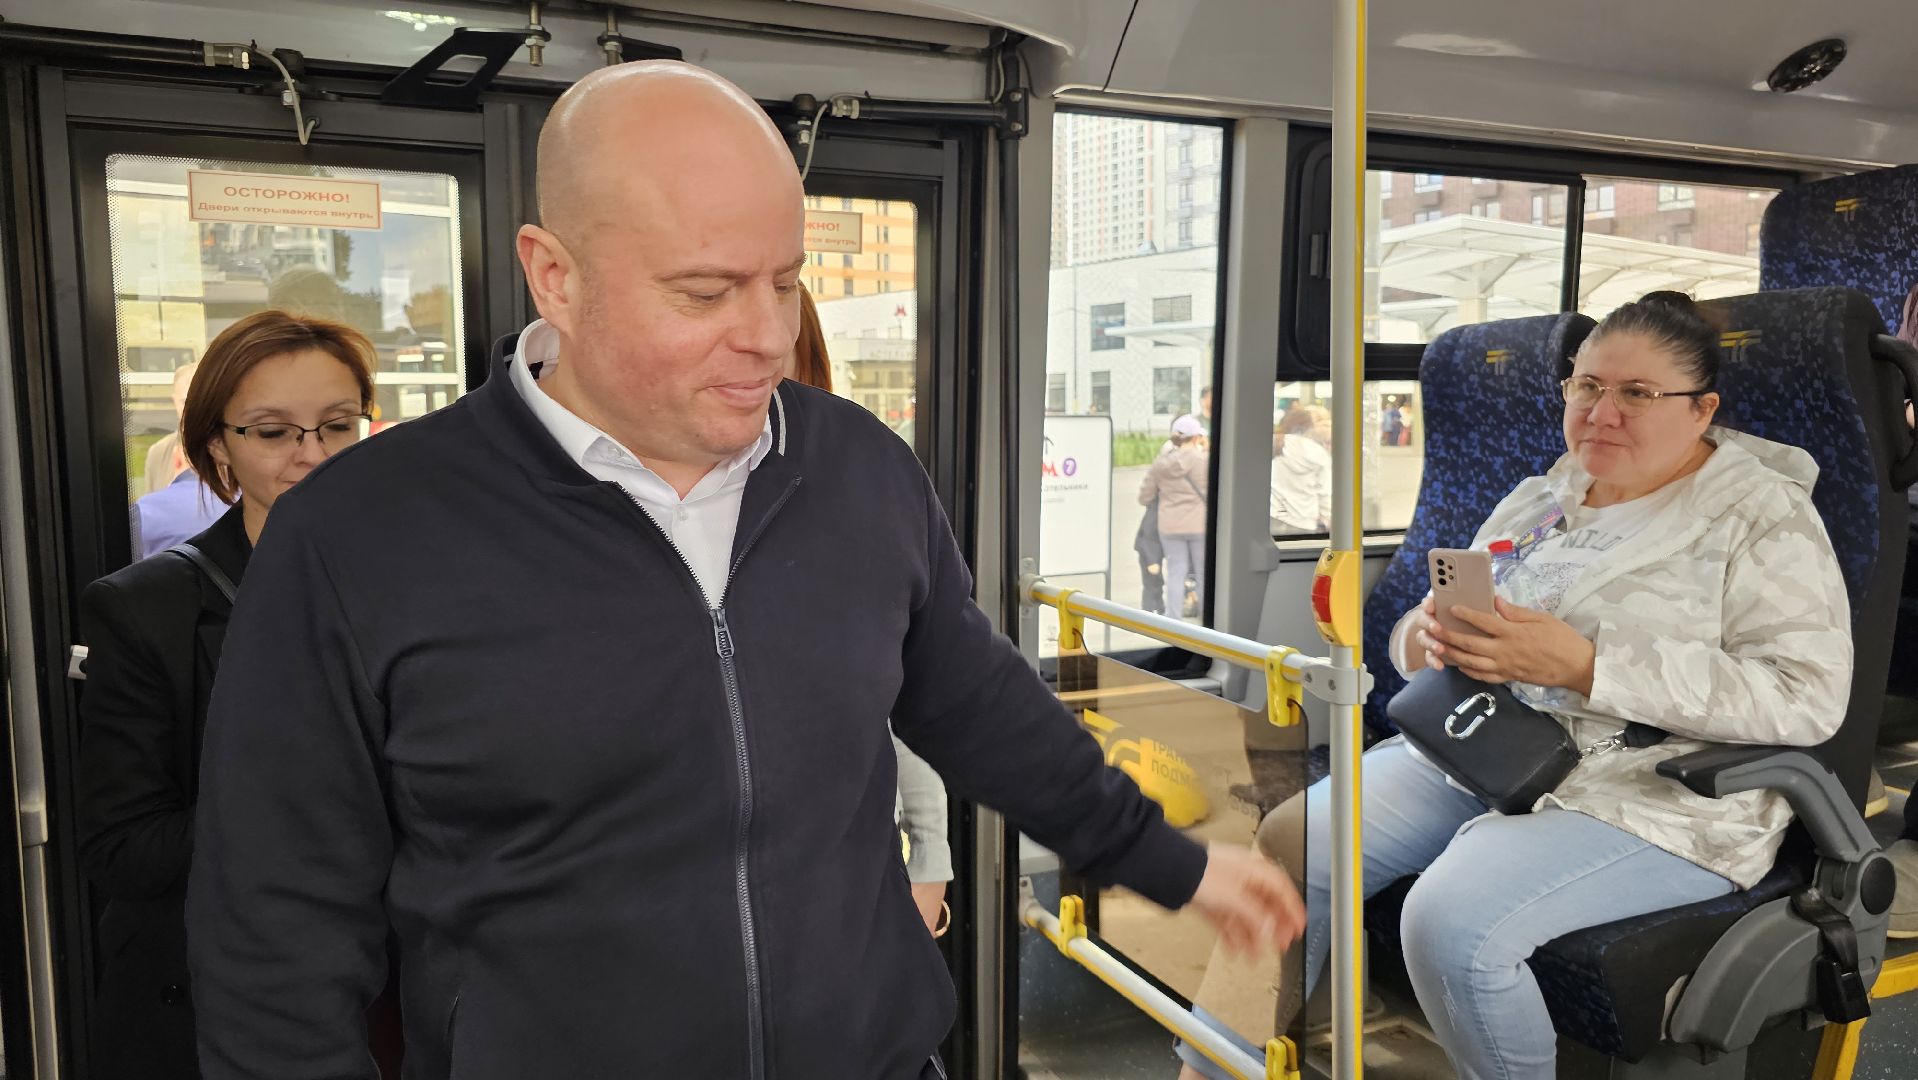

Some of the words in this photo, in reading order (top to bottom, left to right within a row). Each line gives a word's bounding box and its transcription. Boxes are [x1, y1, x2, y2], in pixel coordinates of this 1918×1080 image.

[223, 186, 351, 203] ОСТОРОЖНО!
[198, 202, 240, 213] Двери
[243, 206, 330, 217] открываются
[330, 211, 374, 220] внутрь
